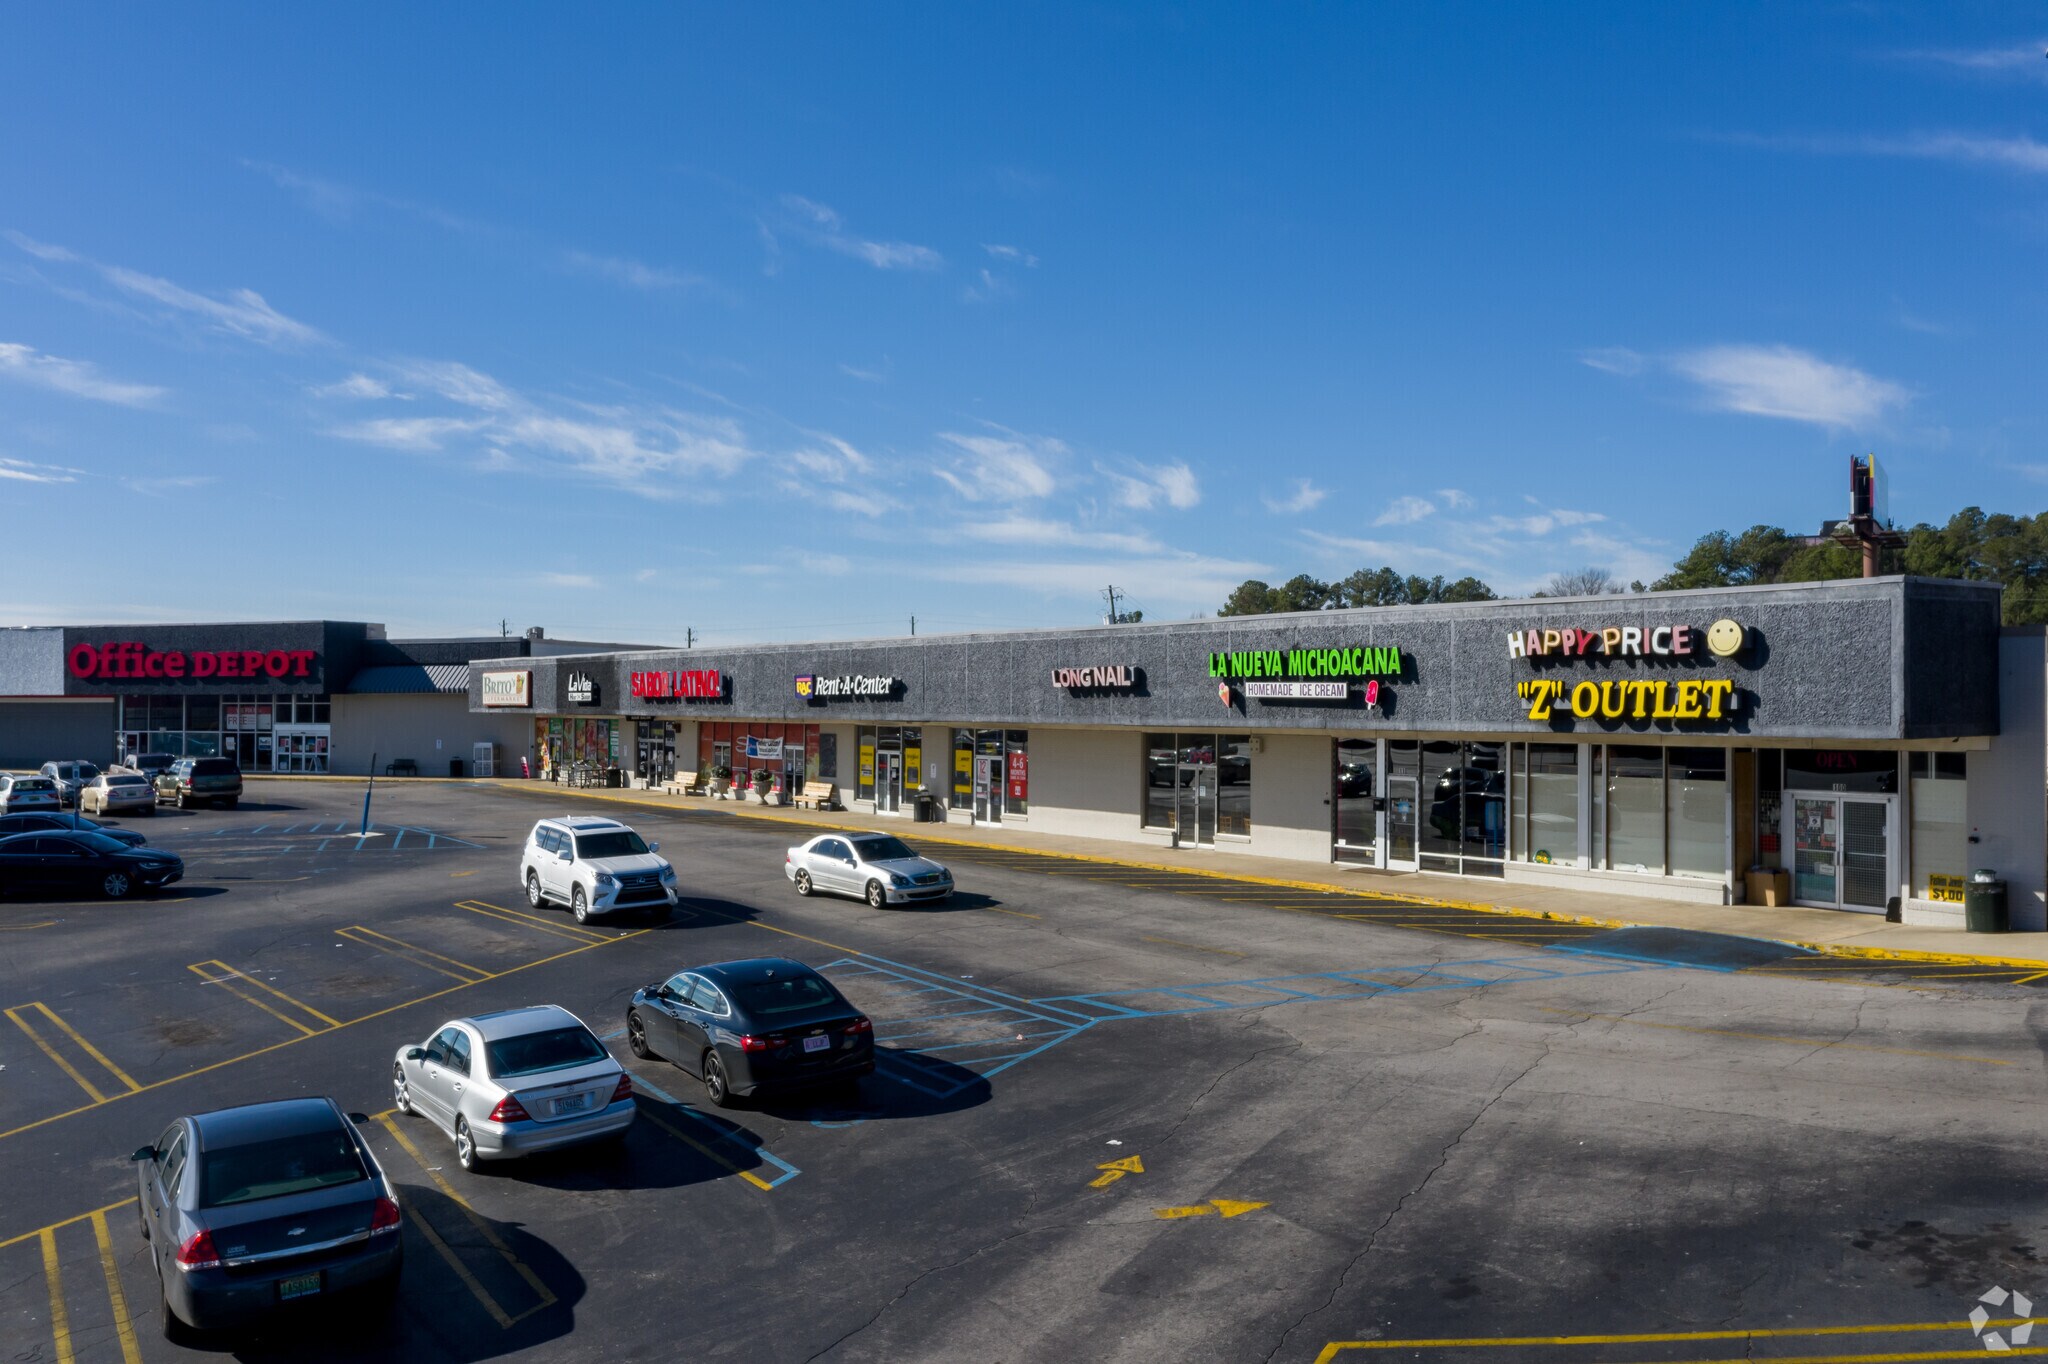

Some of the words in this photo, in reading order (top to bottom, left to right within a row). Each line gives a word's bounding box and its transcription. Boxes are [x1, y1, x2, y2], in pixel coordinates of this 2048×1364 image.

[1507, 626, 1595, 659] HAPPY
[1602, 626, 1692, 655] PRICE
[68, 642, 185, 678] Office
[192, 650, 314, 678] DEPOT
[1209, 652, 1228, 677] LA
[1231, 650, 1283, 676] NUEVA
[1288, 646, 1401, 676] MICHOACANA
[632, 671, 671, 697] SABOR
[673, 669, 721, 697] LATINO!
[796, 681, 812, 696] RAC
[1052, 667, 1091, 687] LONG
[1247, 683, 1293, 696] HOMEMADE
[1299, 683, 1313, 696] ICE
[1314, 683, 1345, 697] CREAM
[1517, 680, 1562, 720] "Z"
[1570, 680, 1732, 719] OUTLET
[1012, 757, 1024, 769] 4-6
